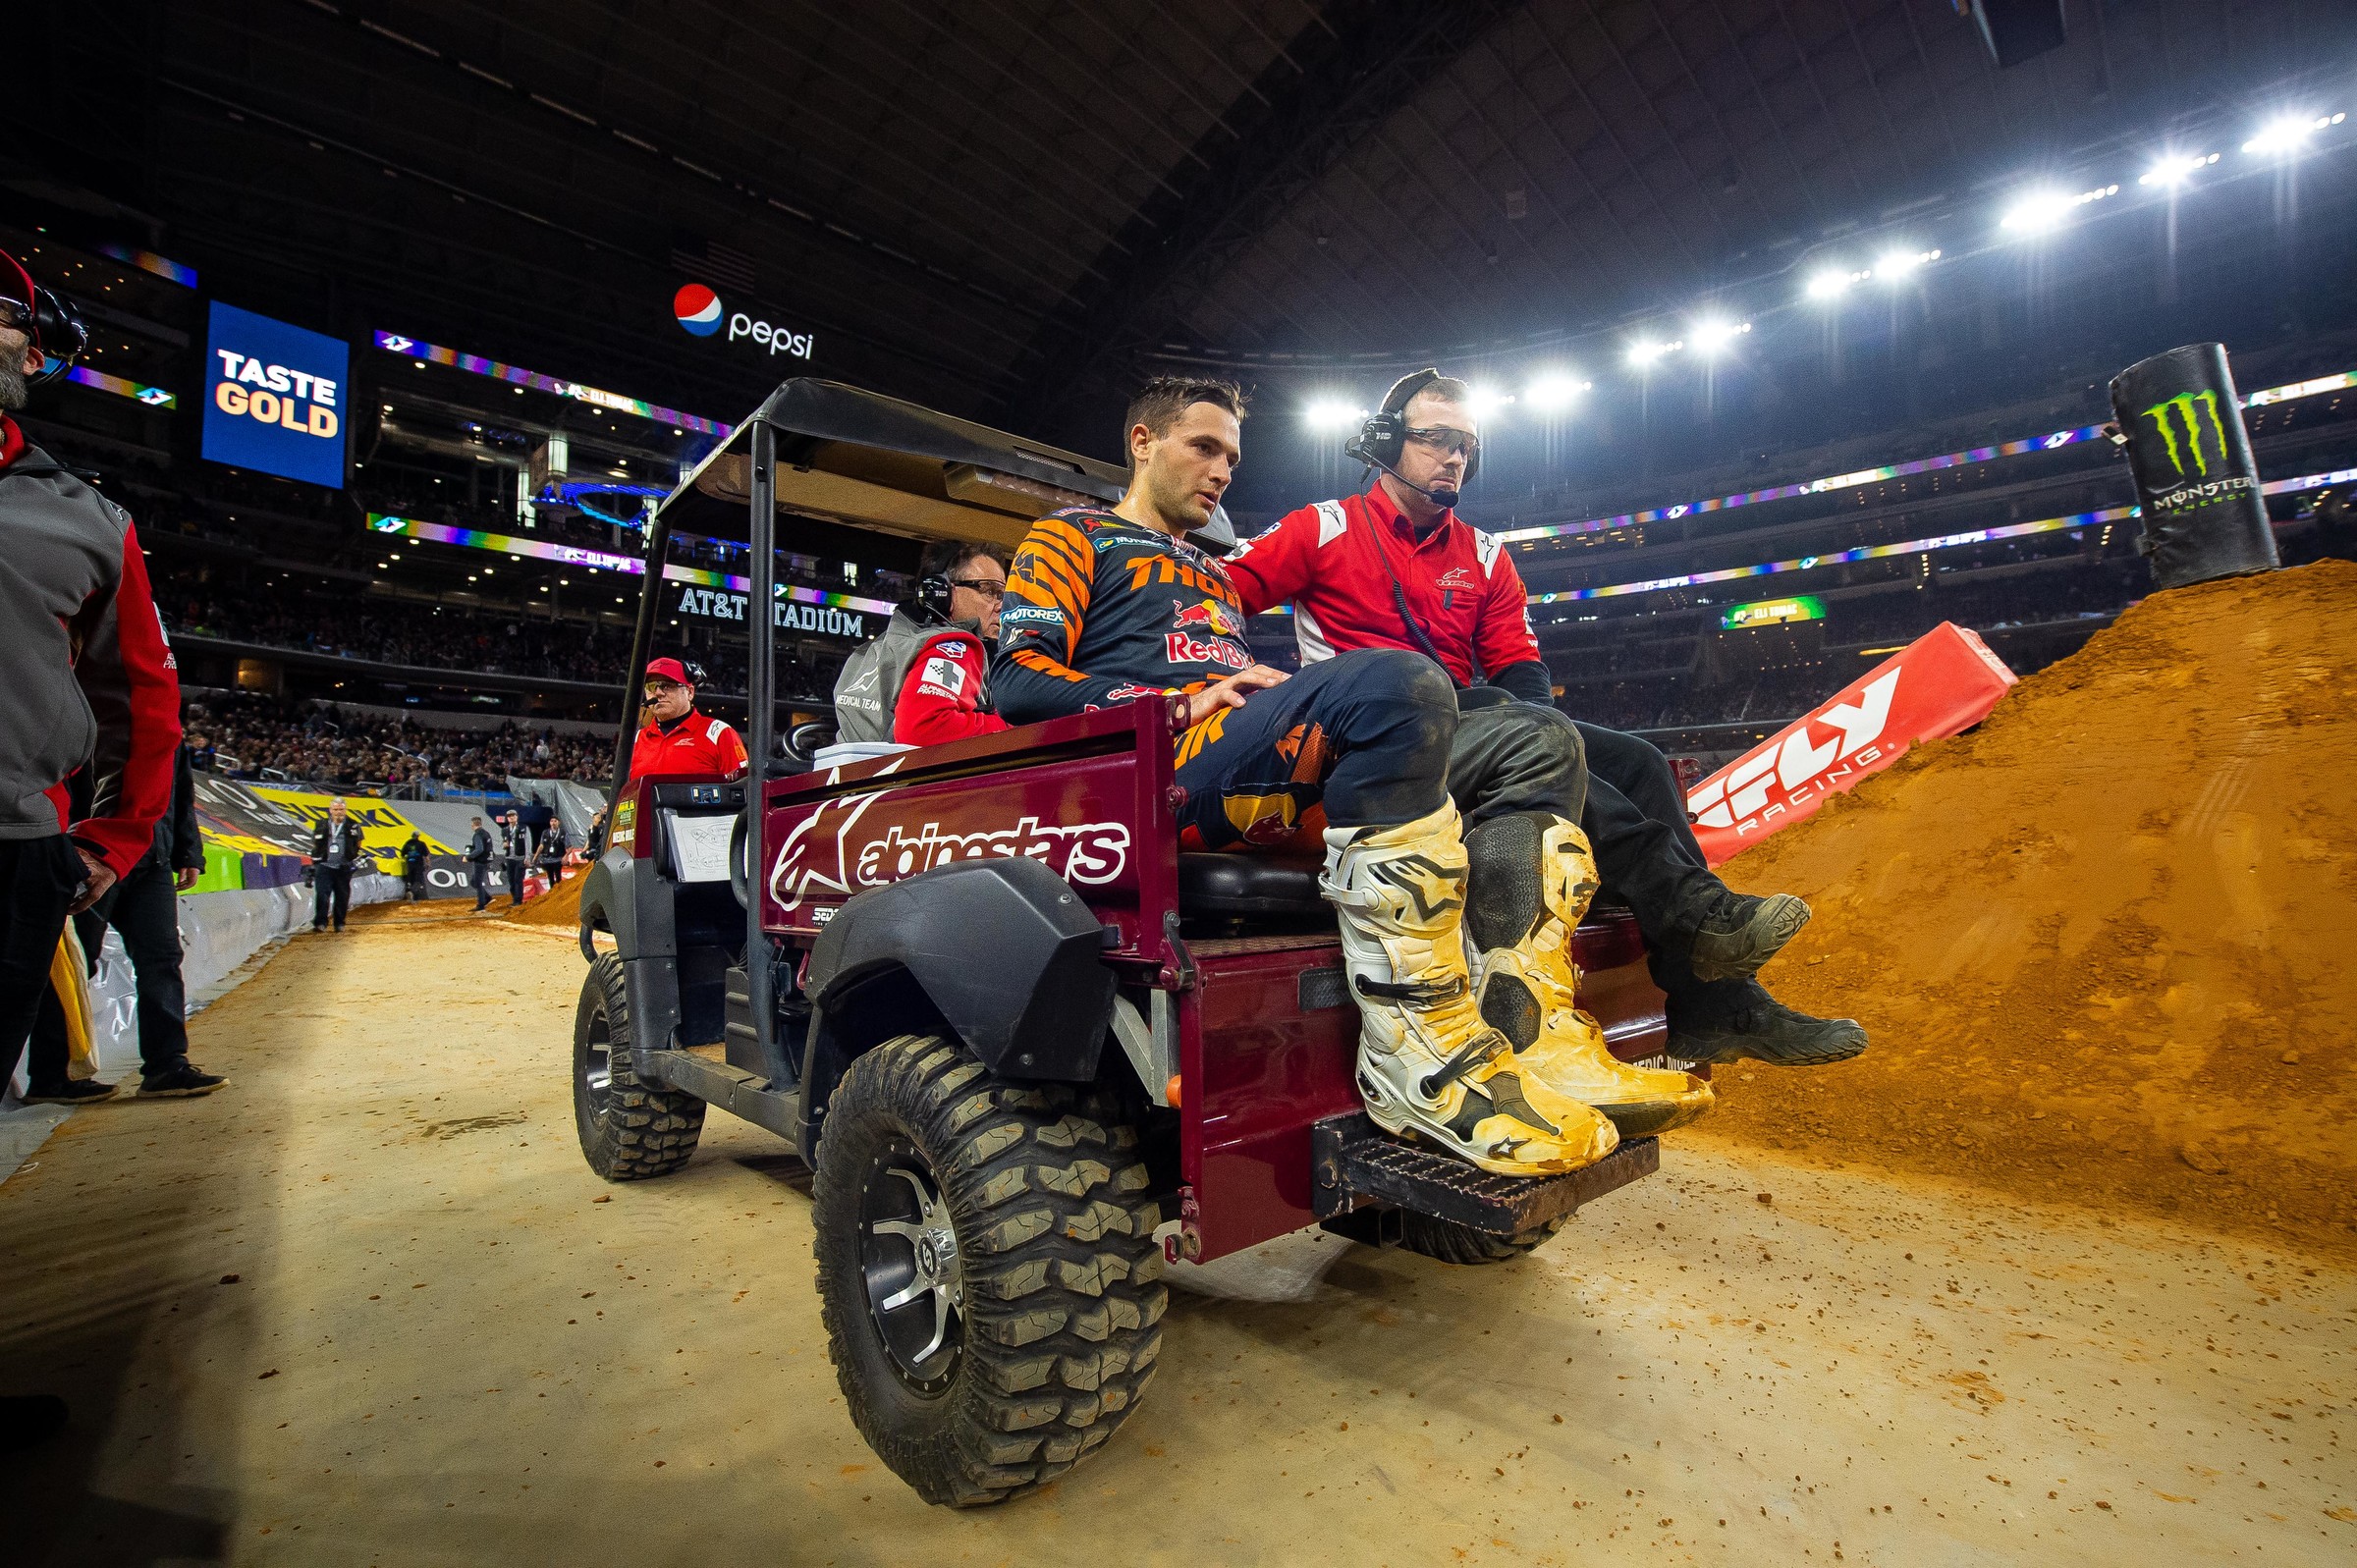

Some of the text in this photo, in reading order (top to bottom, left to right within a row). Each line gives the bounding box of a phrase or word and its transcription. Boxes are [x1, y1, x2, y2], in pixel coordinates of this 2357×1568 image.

[728, 312, 814, 360] pepsi
[217, 349, 337, 406] TASTE
[215, 381, 339, 439] GOLD
[2153, 476, 2252, 511] MONSTER
[2172, 492, 2247, 515] ENERGY
[678, 588, 748, 621] AT&T
[774, 601, 864, 638] TADIUM
[1003, 609, 1065, 623] MOTOREX
[836, 694, 882, 712] MEDICAL TEAM
[1687, 666, 1902, 828] FLY
[268, 800, 406, 828] SUUKI
[1735, 745, 1883, 837] RACING
